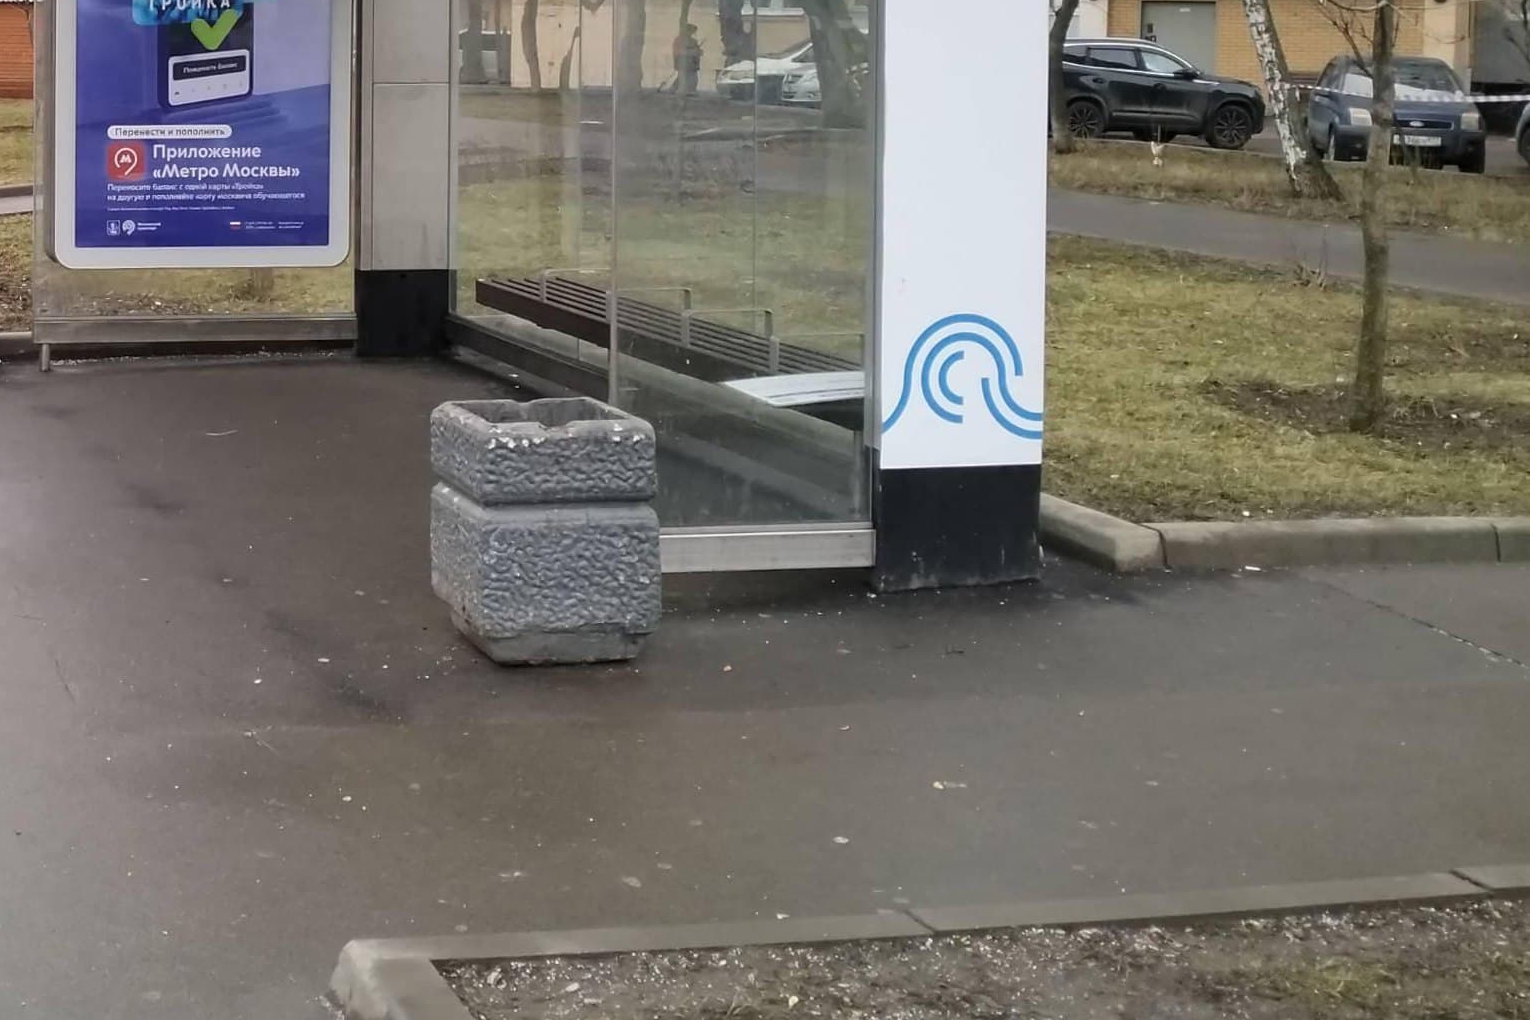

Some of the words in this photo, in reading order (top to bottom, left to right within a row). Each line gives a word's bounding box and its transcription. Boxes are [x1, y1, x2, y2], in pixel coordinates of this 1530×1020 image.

[115, 128, 165, 137] Перенести
[176, 128, 225, 136] пополнить
[153, 145, 262, 161] Приложение
[153, 164, 219, 181] «Метро
[222, 163, 300, 178] Москвы»
